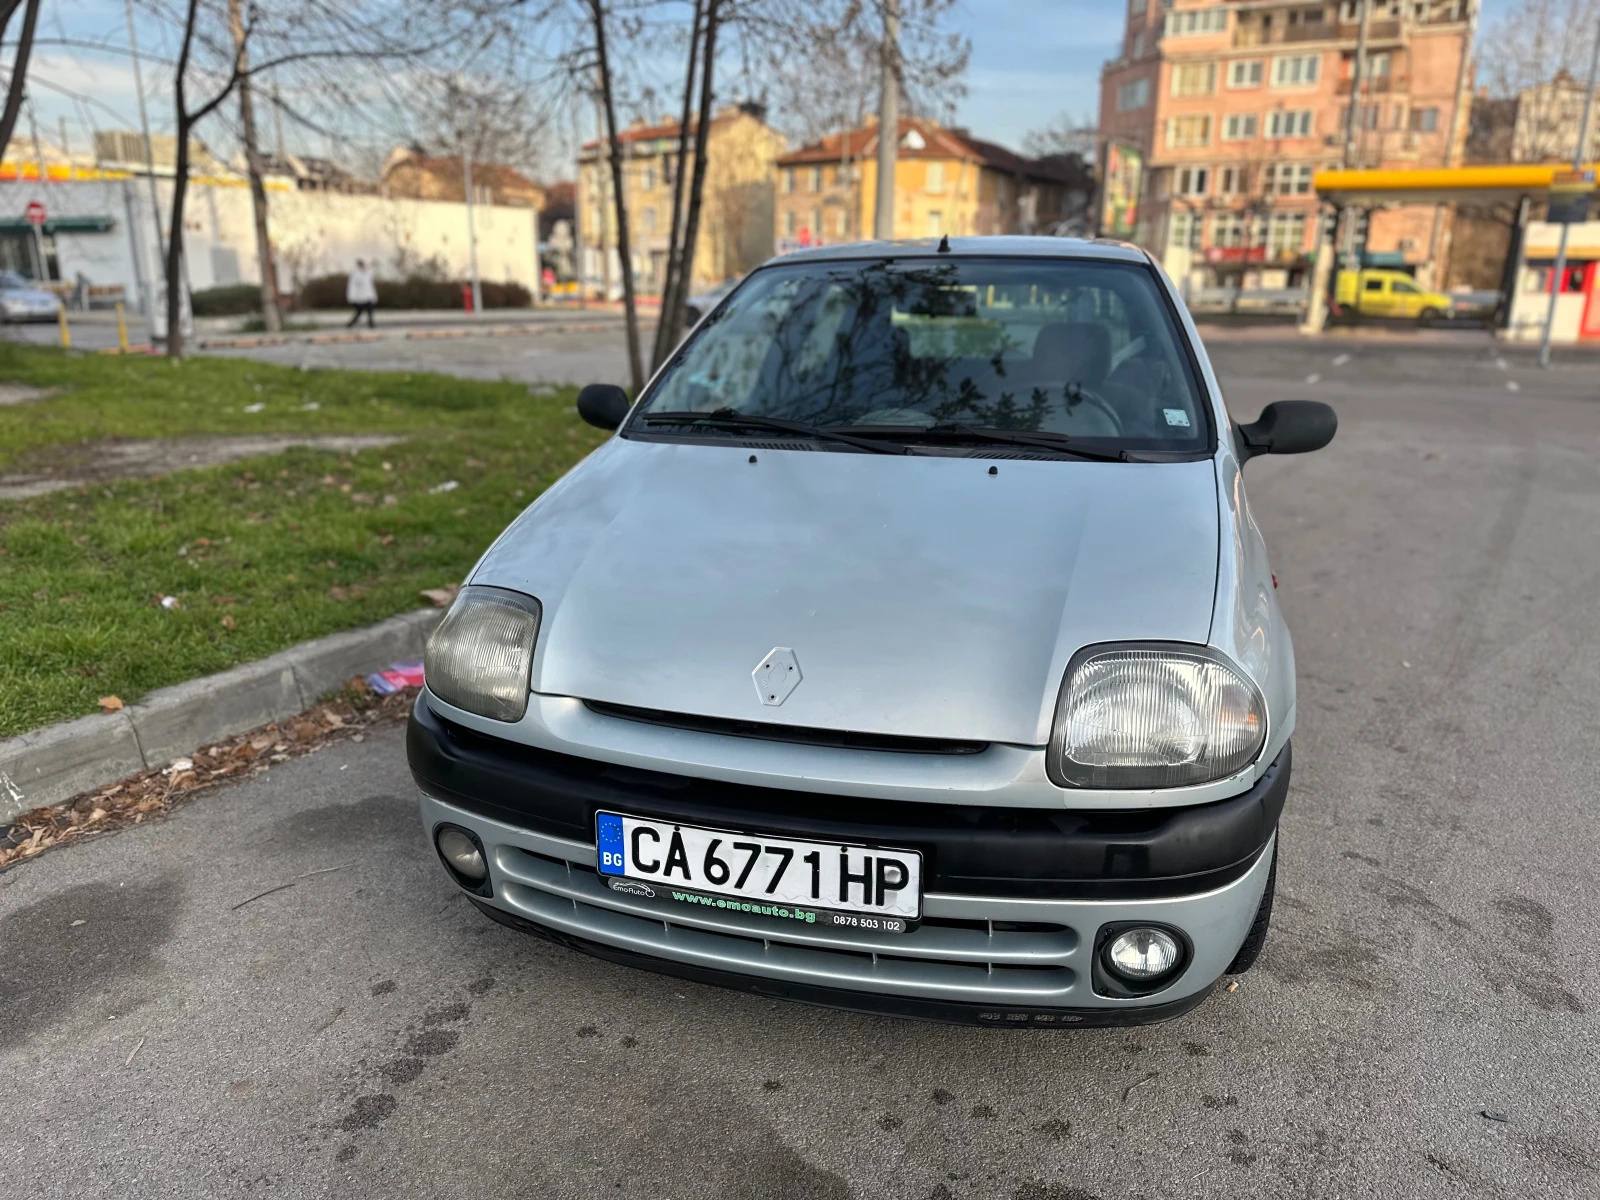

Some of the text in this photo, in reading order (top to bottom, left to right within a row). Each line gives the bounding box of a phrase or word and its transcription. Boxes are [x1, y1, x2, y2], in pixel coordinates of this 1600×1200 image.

[603, 852, 622, 867] BG
[631, 826, 909, 906] CA 6771 HP
[613, 883, 647, 897] EmoAuto
[672, 890, 816, 923] www.emoauto.bg
[833, 915, 900, 931] 0878 503 102
